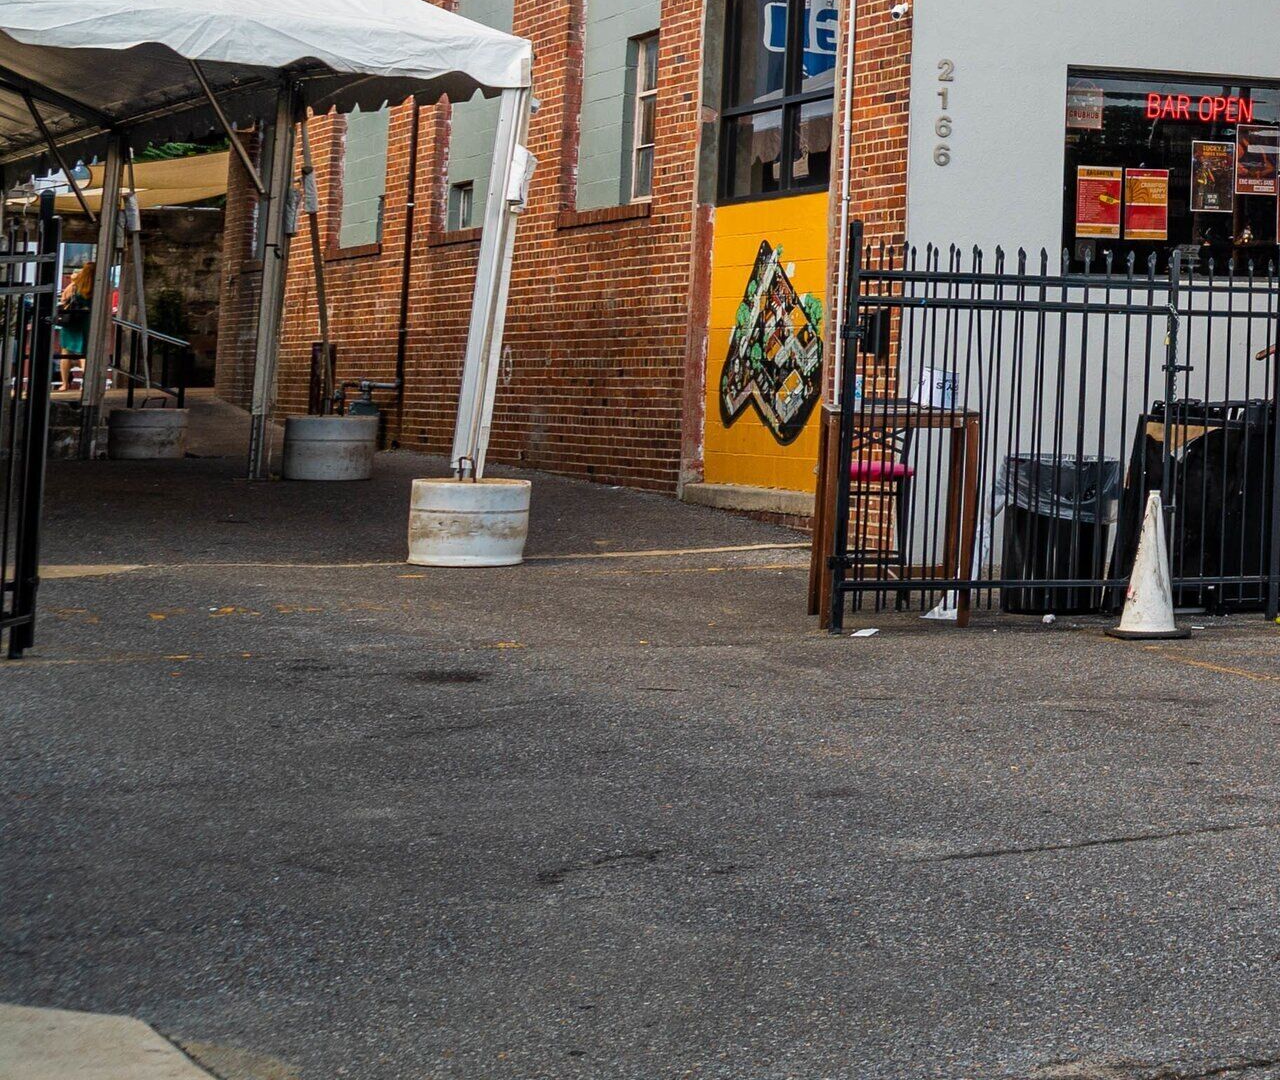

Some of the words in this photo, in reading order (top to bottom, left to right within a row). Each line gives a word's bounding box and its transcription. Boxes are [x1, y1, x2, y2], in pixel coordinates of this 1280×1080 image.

[933, 58, 955, 167] 2166
[1146, 92, 1192, 121] BAR
[1198, 95, 1254, 124] OPEN
